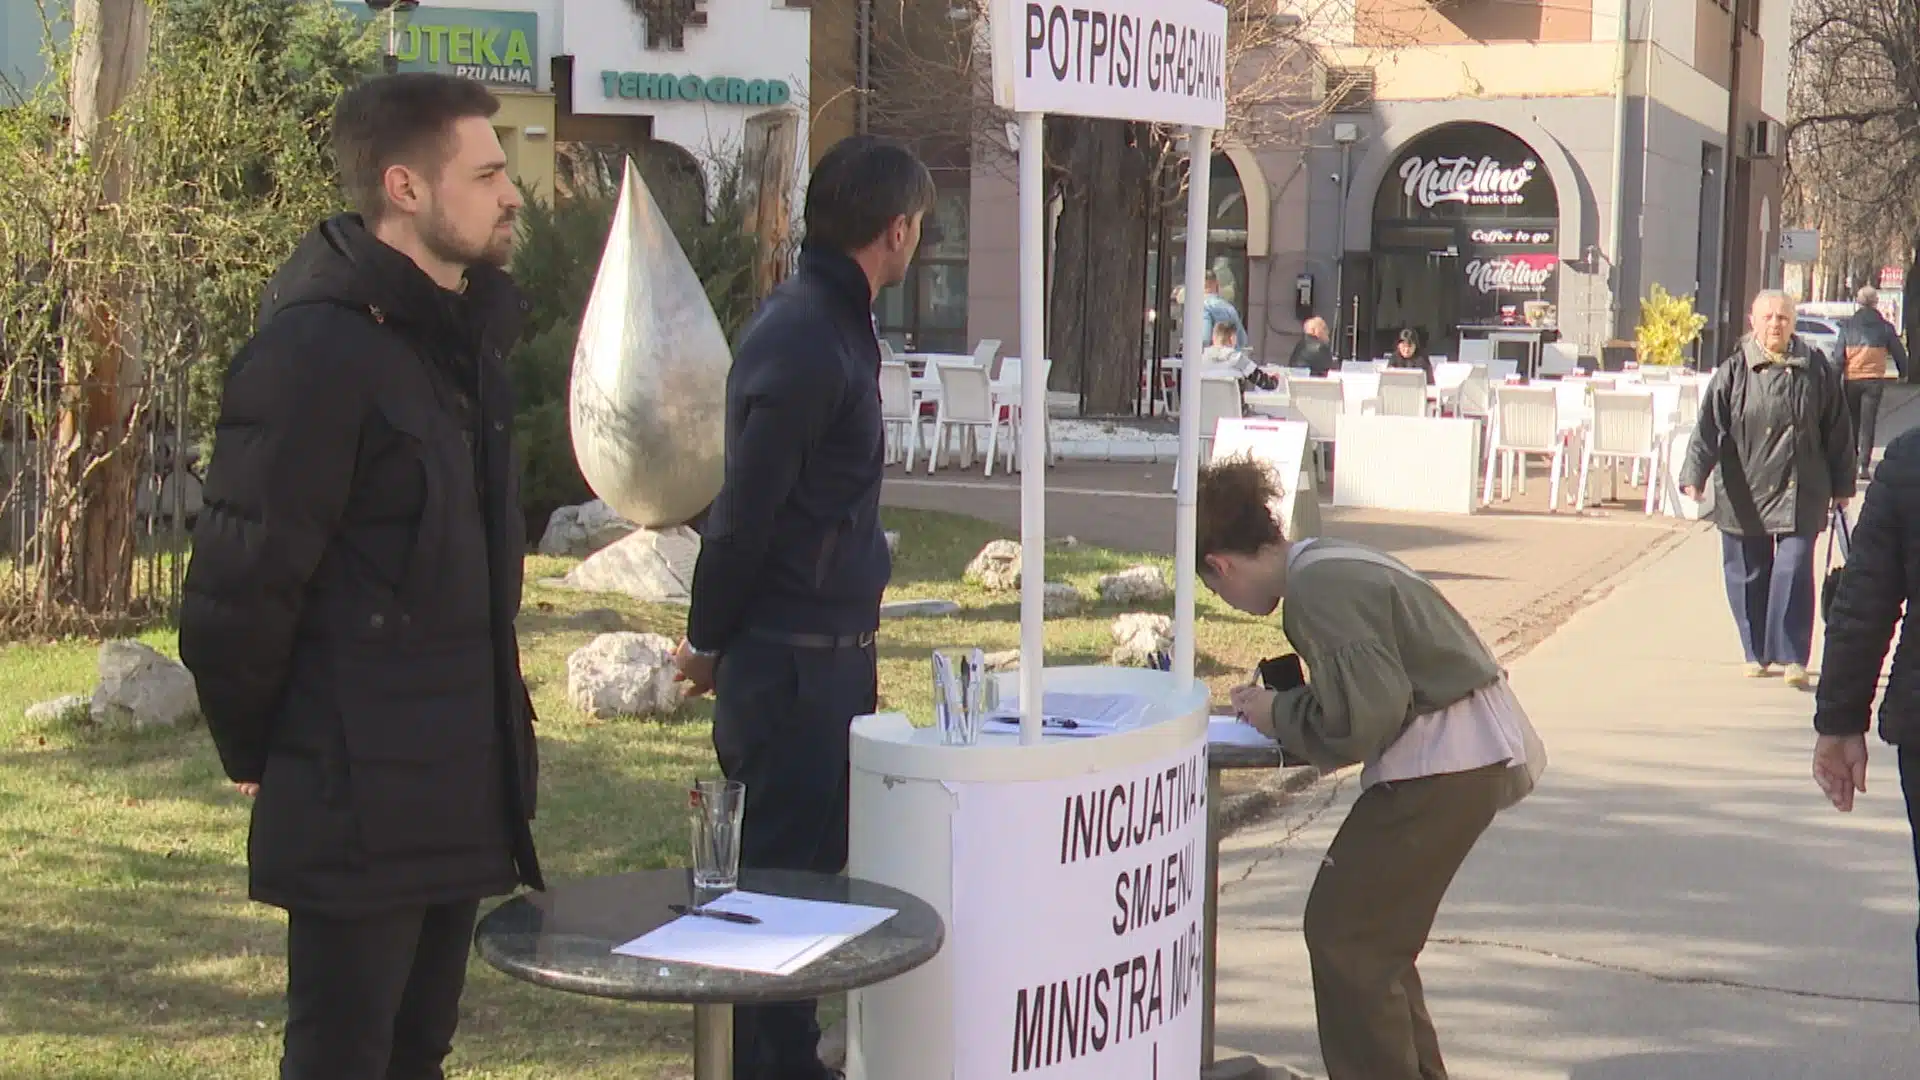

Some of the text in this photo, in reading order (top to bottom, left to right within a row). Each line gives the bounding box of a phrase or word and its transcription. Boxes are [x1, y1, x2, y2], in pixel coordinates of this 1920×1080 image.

[395, 24, 532, 66] OTEKA
[1026, 2, 1222, 101] POTPISI GRAĐANA
[456, 65, 531, 83] PZU ALMA
[601, 70, 790, 105] TEHNOGRAD
[1399, 156, 1532, 208] Nutelino
[1471, 192, 1524, 204] snack cafe
[1471, 229, 1550, 244] Coffee to go
[1465, 259, 1551, 294] Nutelino
[1061, 754, 1196, 864] INICIJATIVA
[1112, 838, 1195, 936] SMJENU
[1011, 948, 1163, 1073] MINISTRA
